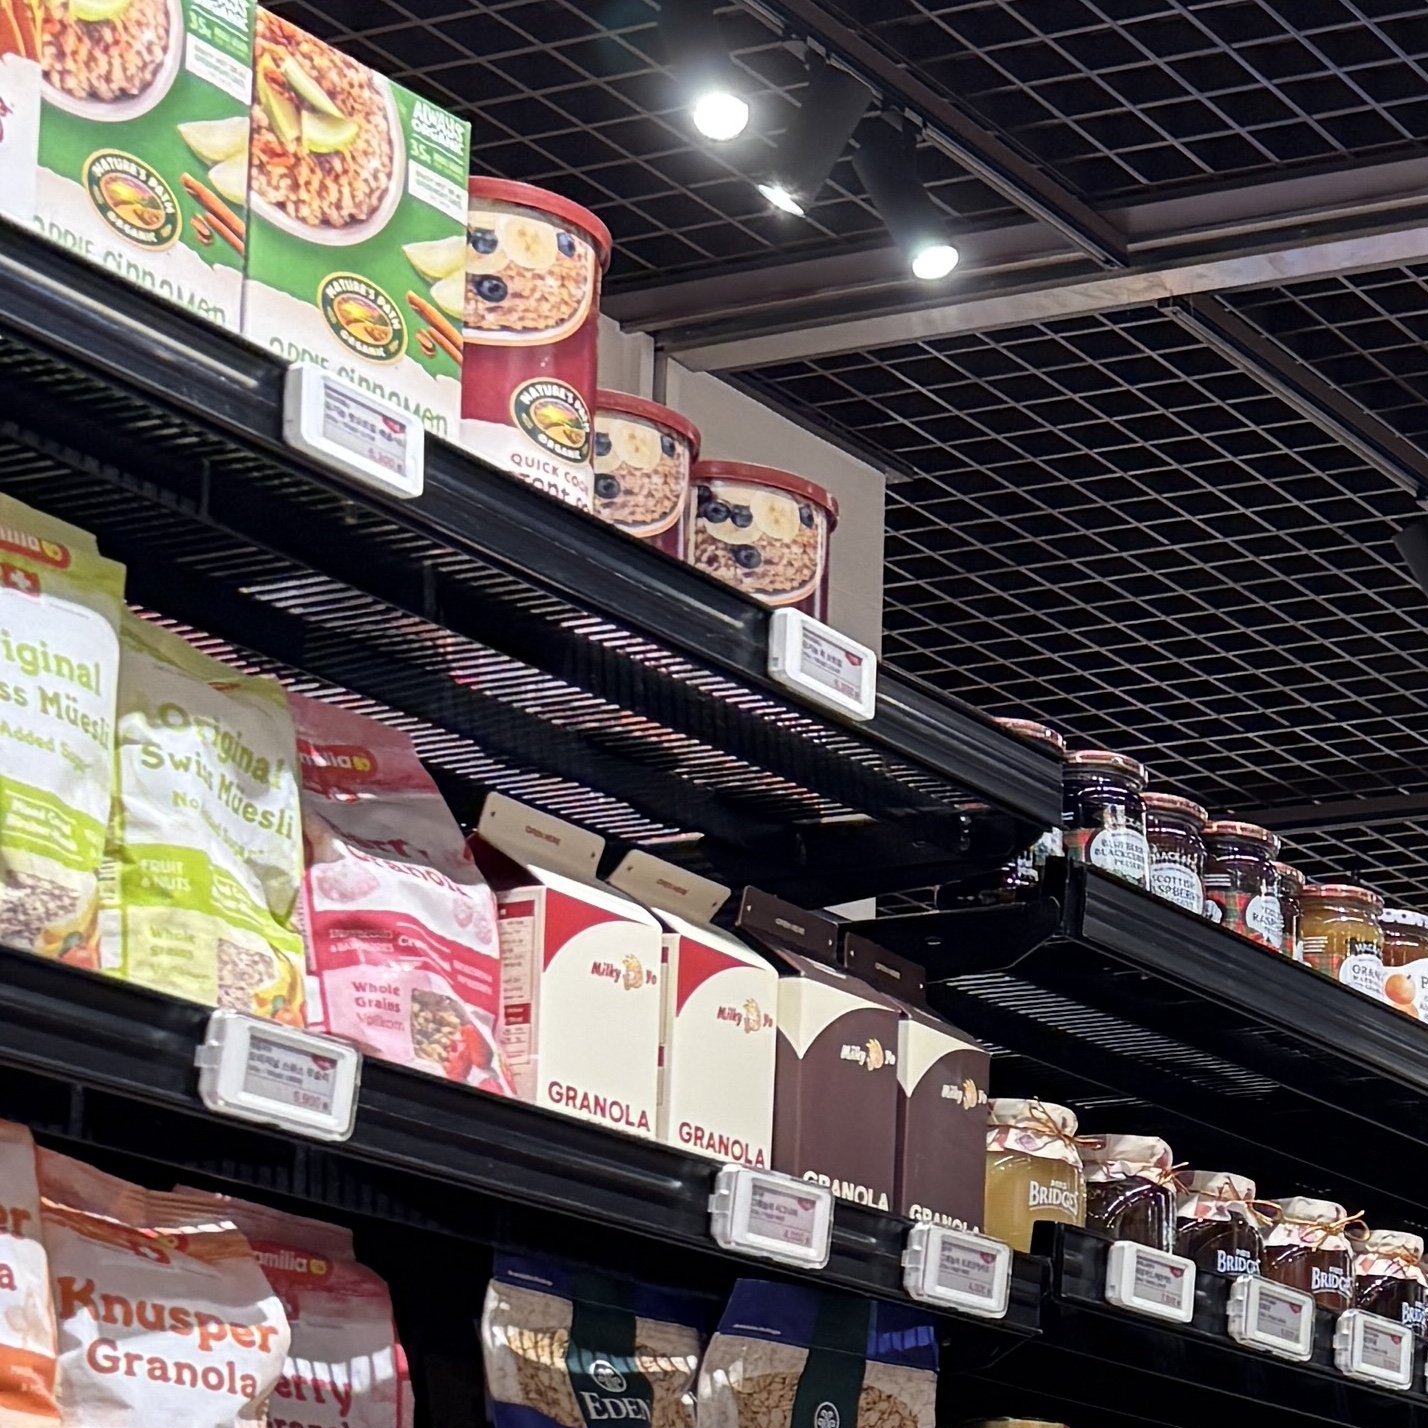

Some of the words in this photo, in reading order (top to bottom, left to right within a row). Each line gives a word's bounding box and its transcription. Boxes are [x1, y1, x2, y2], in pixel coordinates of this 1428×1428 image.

[510, 452, 558, 476] QUICK
[352, 979, 401, 998] Whole
[590, 960, 621, 985] Milky
[354, 996, 401, 1015] Grains
[716, 1005, 744, 1027] Milky
[547, 1079, 651, 1133] GRANOLA
[679, 1121, 765, 1169] GRANOLA
[802, 1169, 890, 1210] GRANOLA
[1027, 1179, 1079, 1216] BRIDGES
[254, 1249, 308, 1272] amilia
[57, 1274, 280, 1354] Knusper
[86, 1337, 258, 1400] Granola
[275, 1374, 352, 1418] erry
[582, 1389, 652, 1421] EDEN
